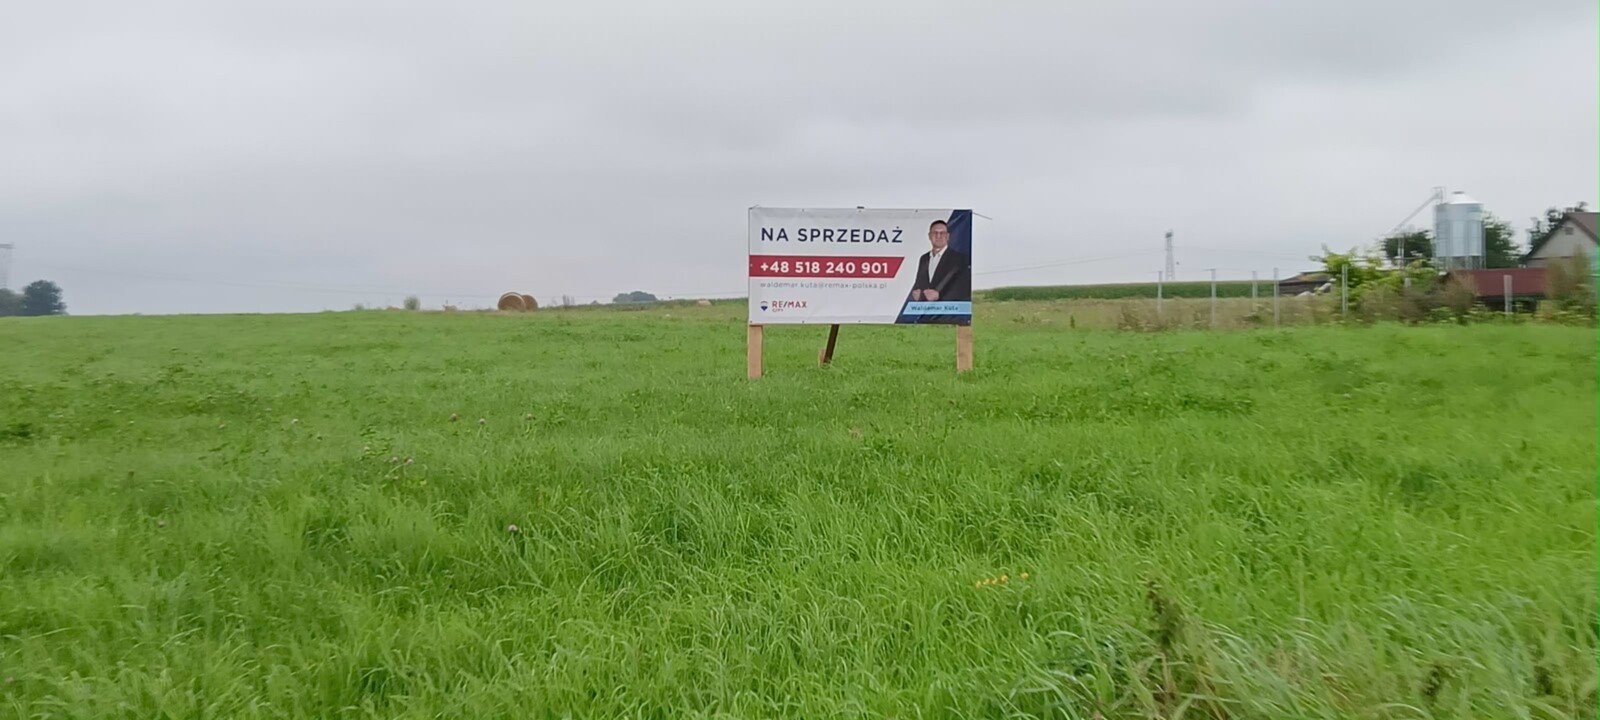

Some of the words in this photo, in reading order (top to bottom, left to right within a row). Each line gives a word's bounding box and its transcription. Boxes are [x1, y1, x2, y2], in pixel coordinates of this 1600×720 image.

[761, 227, 789, 242] NA
[797, 226, 903, 243] SPRZEDAŻ
[760, 261, 790, 273] +48
[795, 261, 820, 274] 518
[825, 262, 856, 274] 240
[861, 262, 888, 274] 901
[772, 300, 807, 308] RE/MAX
